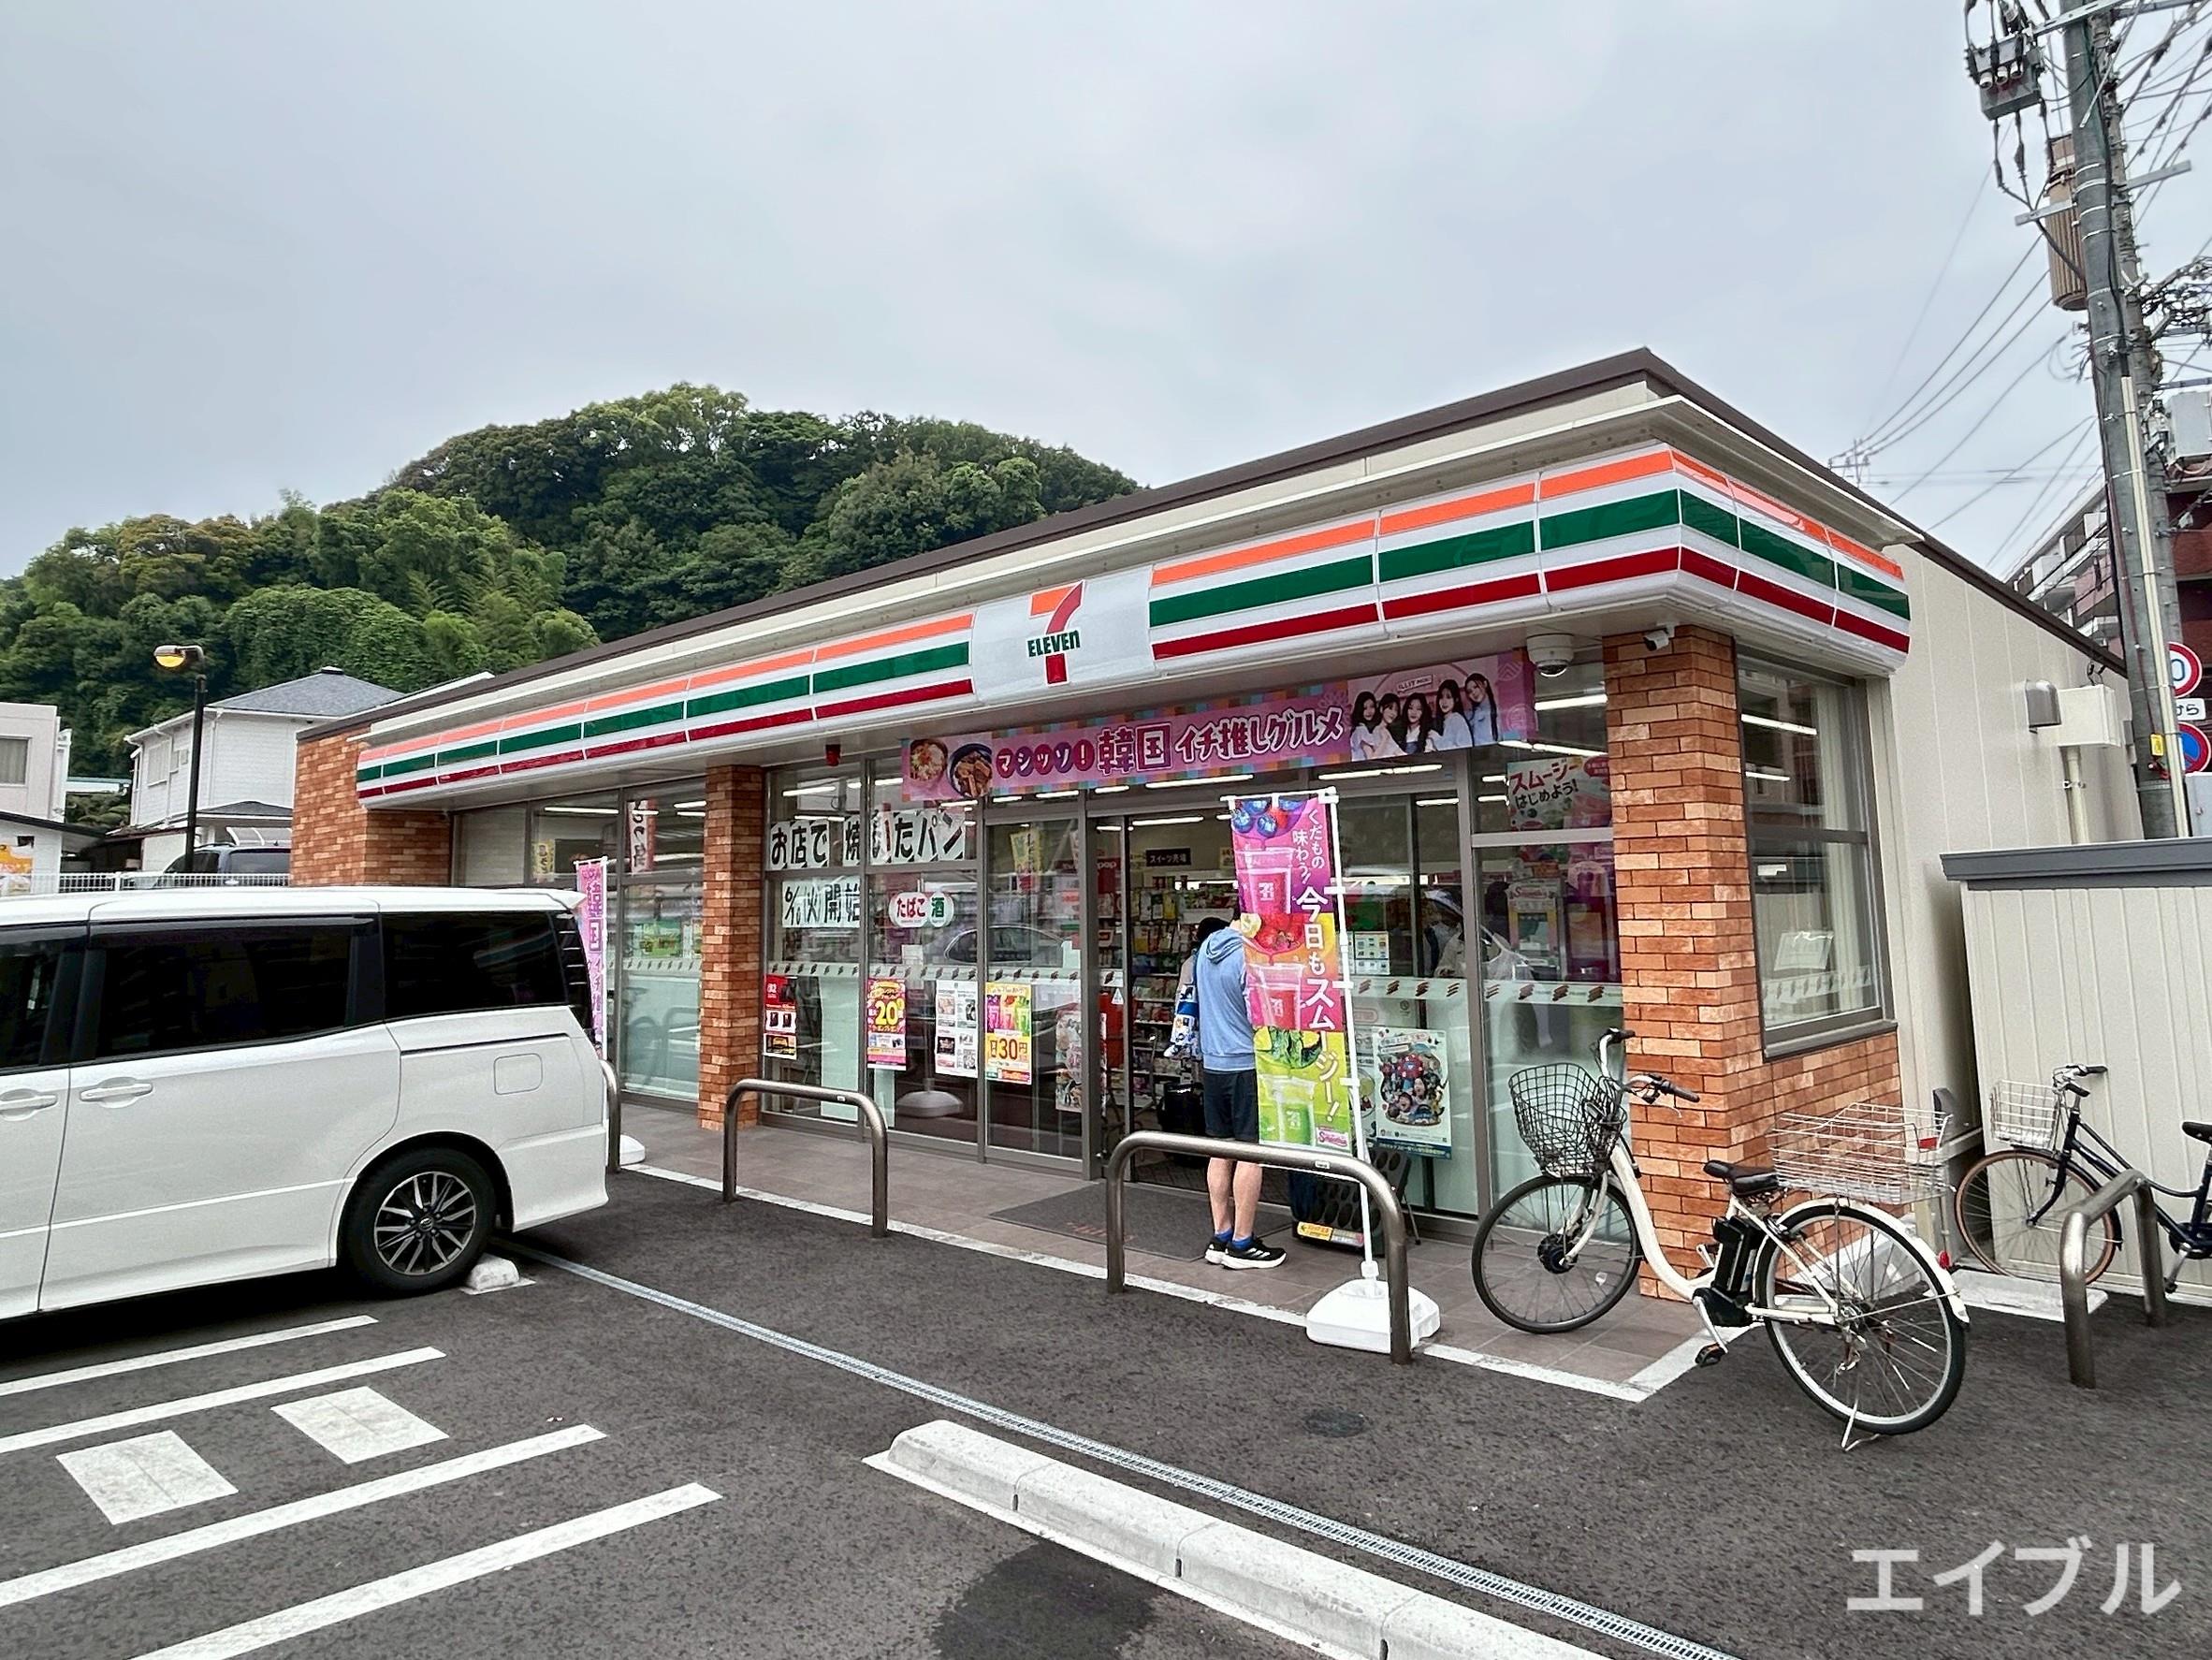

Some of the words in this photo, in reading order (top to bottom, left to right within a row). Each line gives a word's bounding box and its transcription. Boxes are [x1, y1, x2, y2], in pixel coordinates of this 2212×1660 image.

[1030, 581, 1084, 685] 7
[2171, 659, 2185, 681] 0
[1511, 759, 1579, 795] スムージー
[1515, 779, 1579, 809] はじめよう!
[1309, 808, 1325, 869] くだもの
[896, 897, 926, 918] たばこ
[931, 897, 945, 918] 酒
[1296, 886, 1339, 1122] 今日もスムージー!
